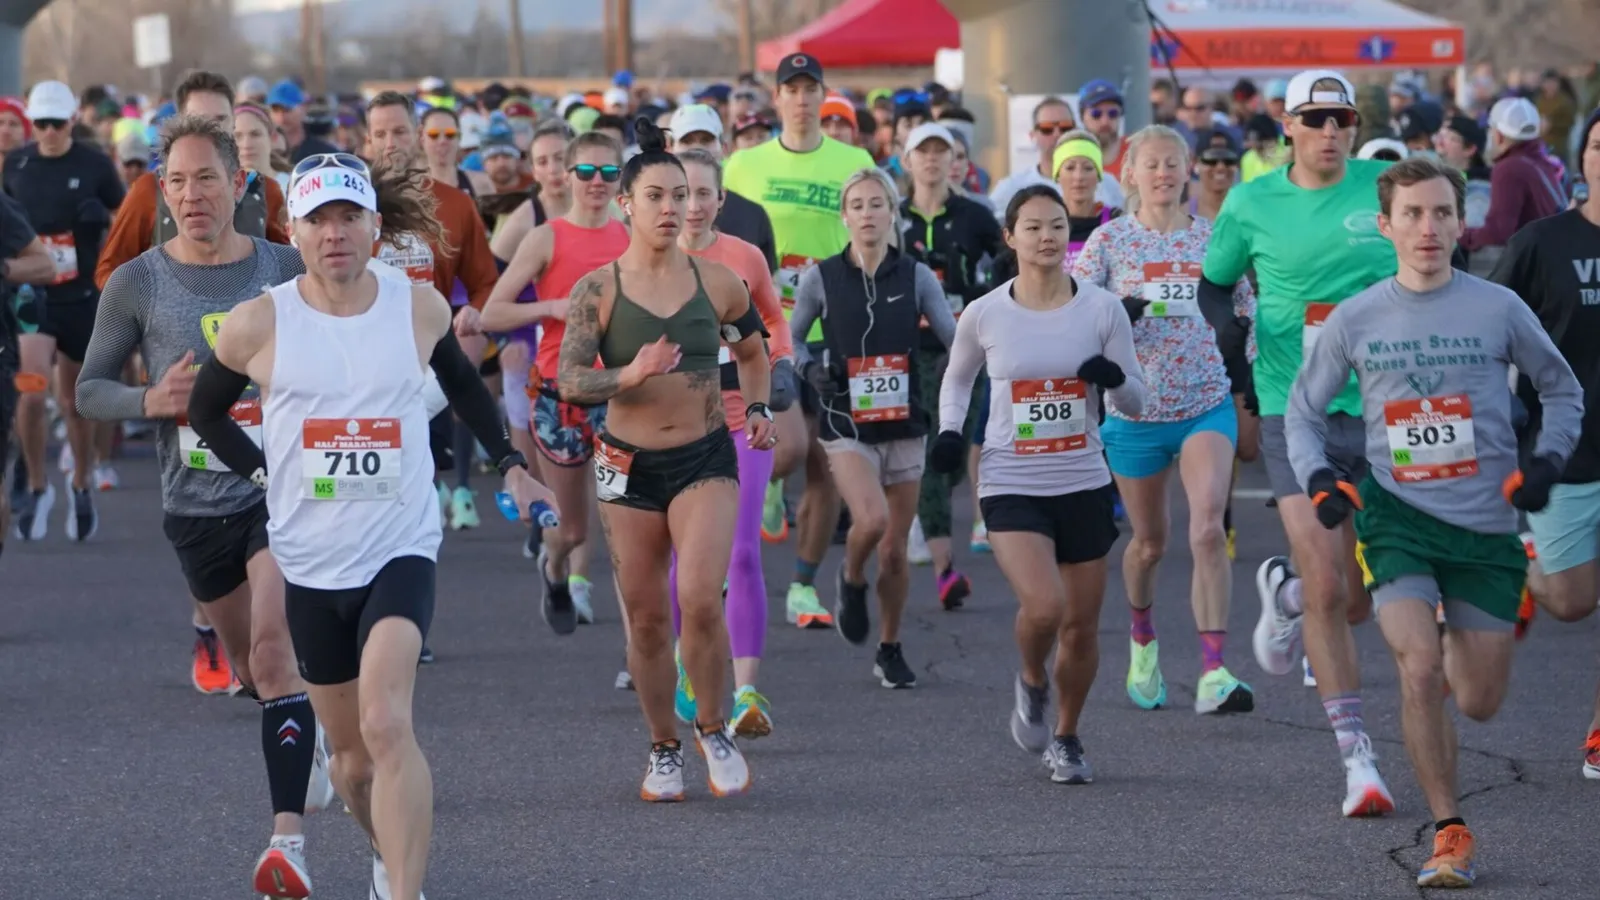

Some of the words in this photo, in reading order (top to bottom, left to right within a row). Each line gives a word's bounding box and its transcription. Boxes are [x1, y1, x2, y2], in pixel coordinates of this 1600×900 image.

[1204, 38, 1325, 61] MEDICAL
[299, 176, 321, 198] RUN
[324, 173, 341, 188] LA
[1160, 283, 1195, 300] 323
[1429, 334, 1482, 349] STATE
[1415, 352, 1487, 368] COUNTRY
[863, 376, 900, 394] 320
[1029, 402, 1072, 422] 508
[1407, 424, 1456, 446] 503
[314, 441, 337, 449] HALF
[339, 440, 391, 449] MARATHON
[324, 451, 381, 476] 710
[314, 483, 334, 494] MS
